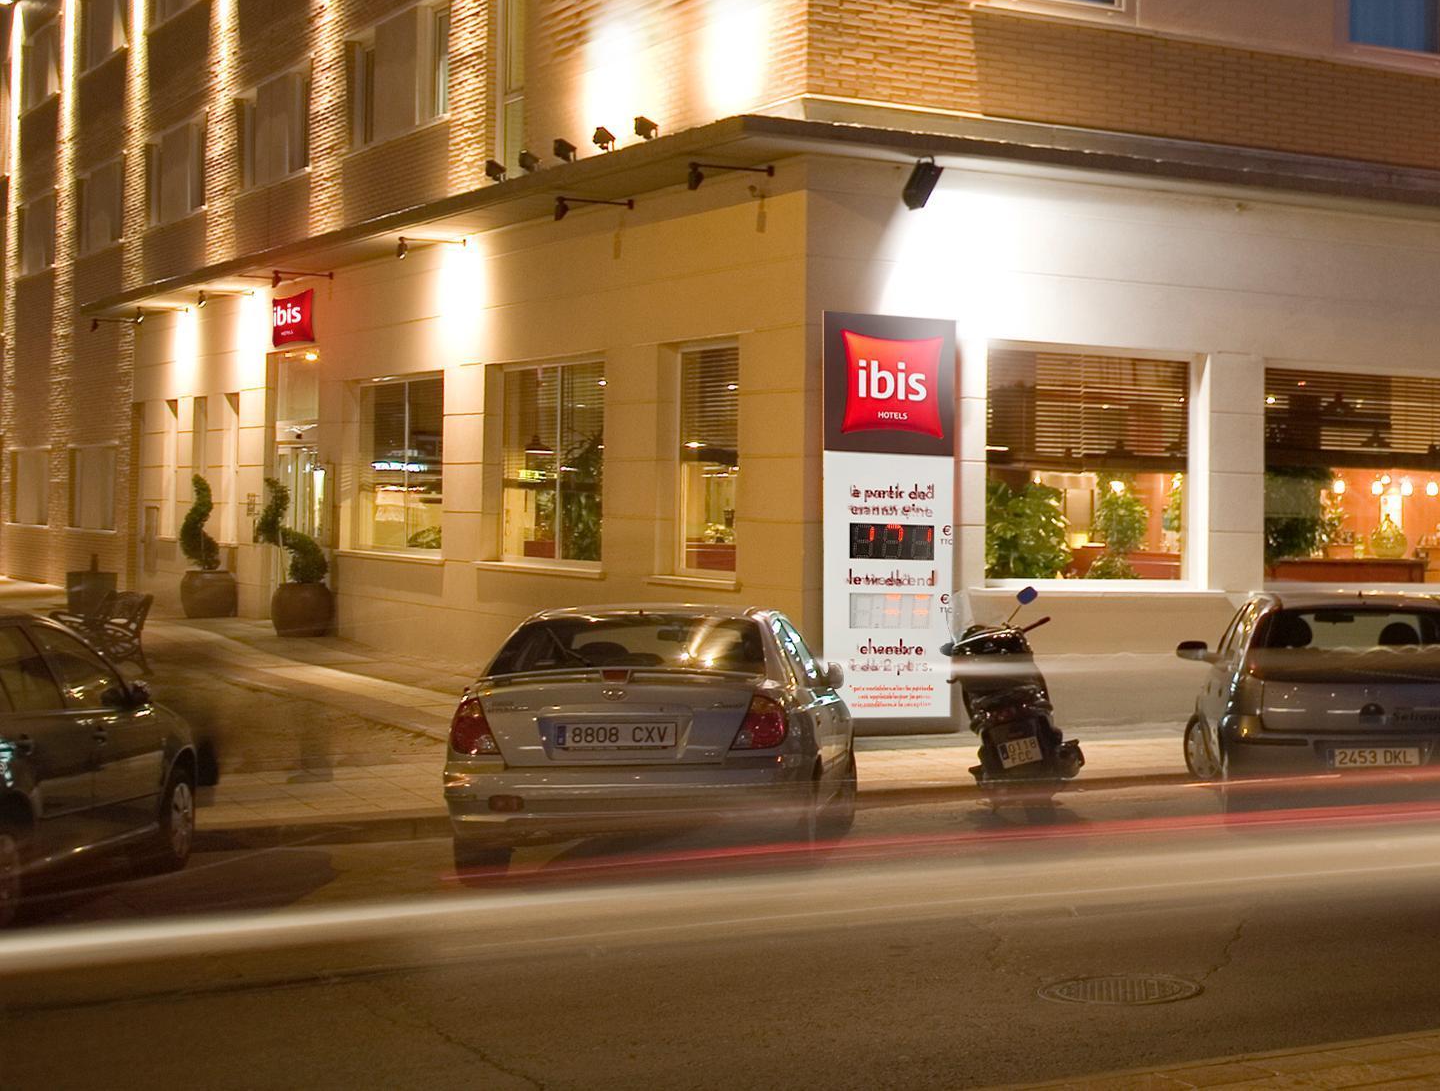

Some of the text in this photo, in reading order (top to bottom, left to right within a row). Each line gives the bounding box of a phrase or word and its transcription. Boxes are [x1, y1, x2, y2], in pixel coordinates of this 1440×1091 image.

[273, 302, 302, 328] ibis
[858, 359, 928, 402] ibis
[877, 411, 909, 420] HOTELS
[571, 726, 668, 744] 8808 CXV
[1338, 749, 1413, 765] 2453 DKL
